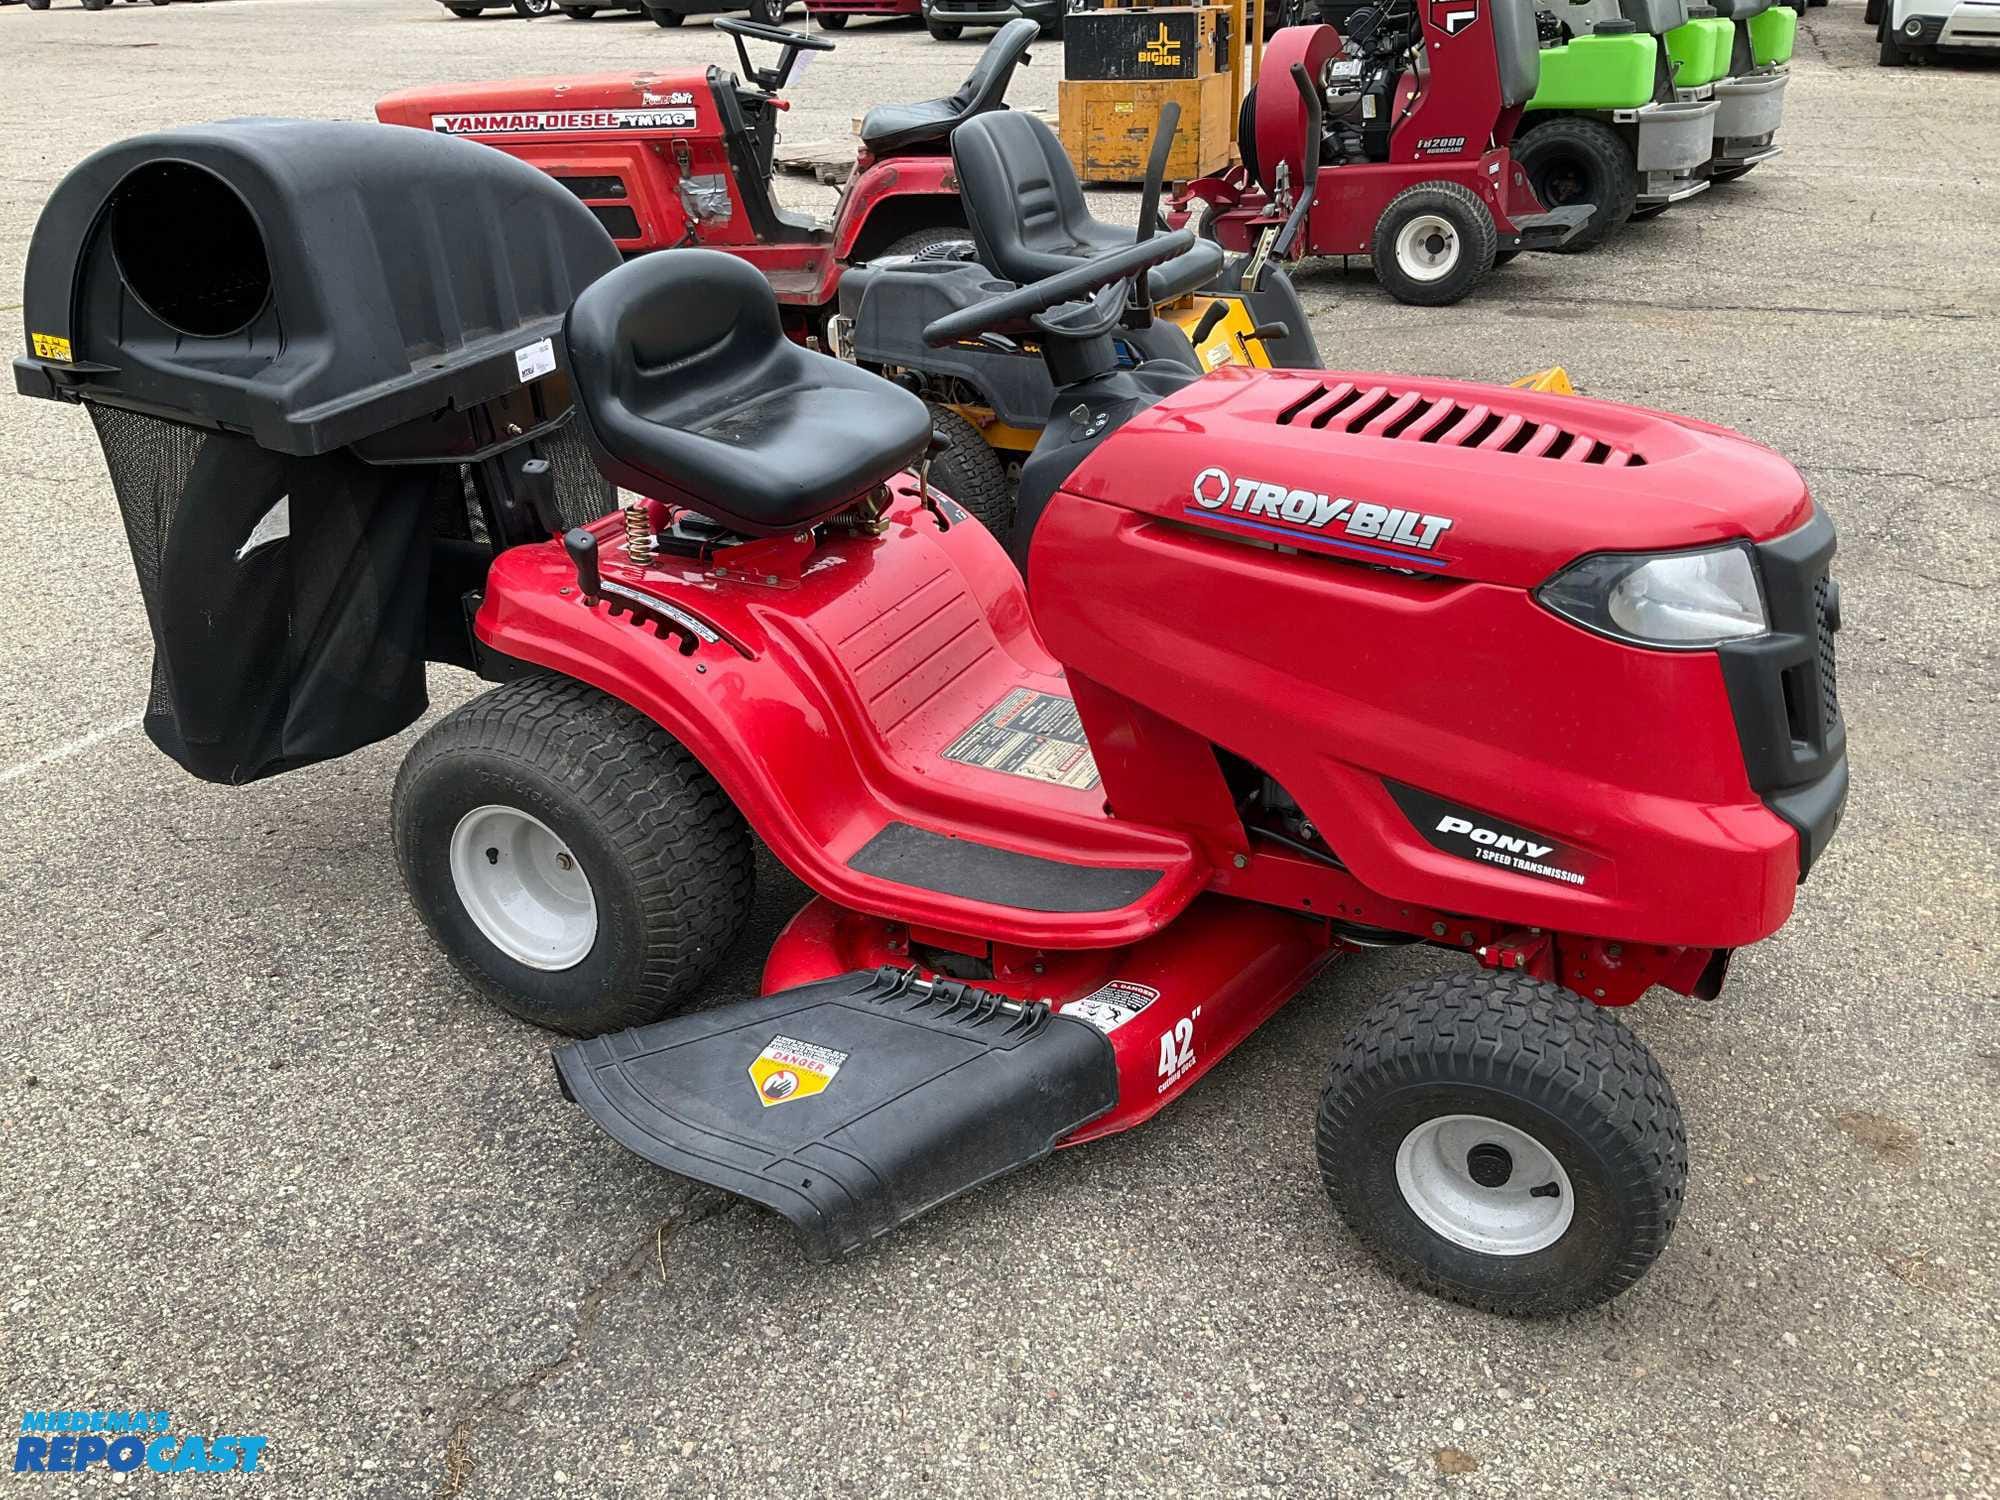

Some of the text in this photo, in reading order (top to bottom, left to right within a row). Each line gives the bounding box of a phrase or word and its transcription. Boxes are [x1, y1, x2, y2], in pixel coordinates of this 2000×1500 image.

[1138, 52, 1181, 66] BIG JOE
[445, 113, 686, 131] YANMAR DIESEL YM146
[1231, 478, 1452, 550] TROY-BILT
[1475, 847, 1585, 885] 7 SPEED TRANSMISSION
[1120, 984, 1155, 998] DANGER
[1158, 1004, 1202, 1077] 42"
[772, 1051, 826, 1073] DANGER
